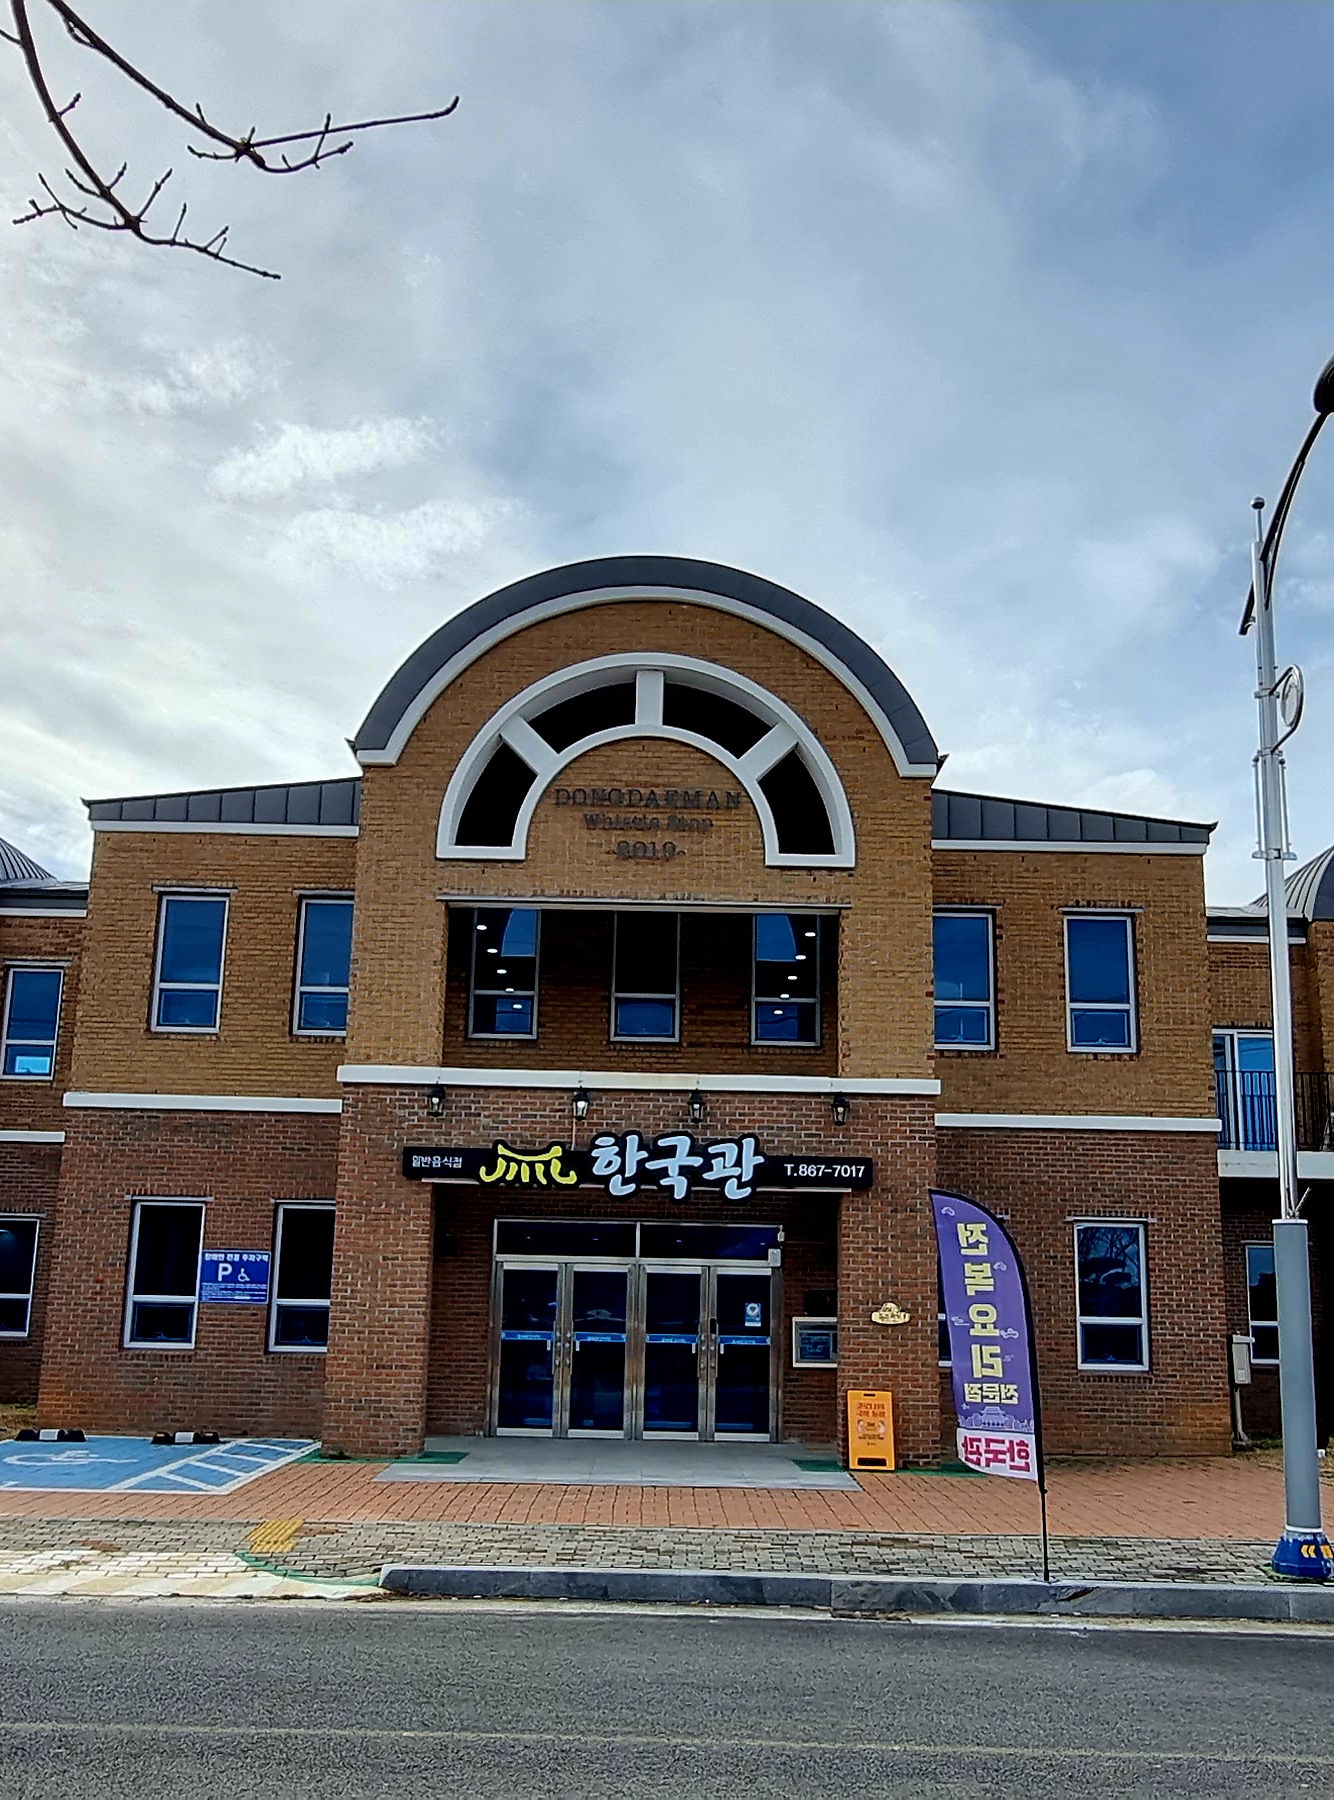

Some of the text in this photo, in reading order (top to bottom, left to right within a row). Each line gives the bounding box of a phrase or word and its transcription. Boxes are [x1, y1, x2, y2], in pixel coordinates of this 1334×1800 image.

[554, 788, 742, 809] DONGDAEMAN
[412, 1155, 463, 1169] 일반음식점
[590, 1134, 765, 1200] 한국관
[784, 1163, 866, 1178] T.867-7017
[218, 1263, 233, 1281] P
